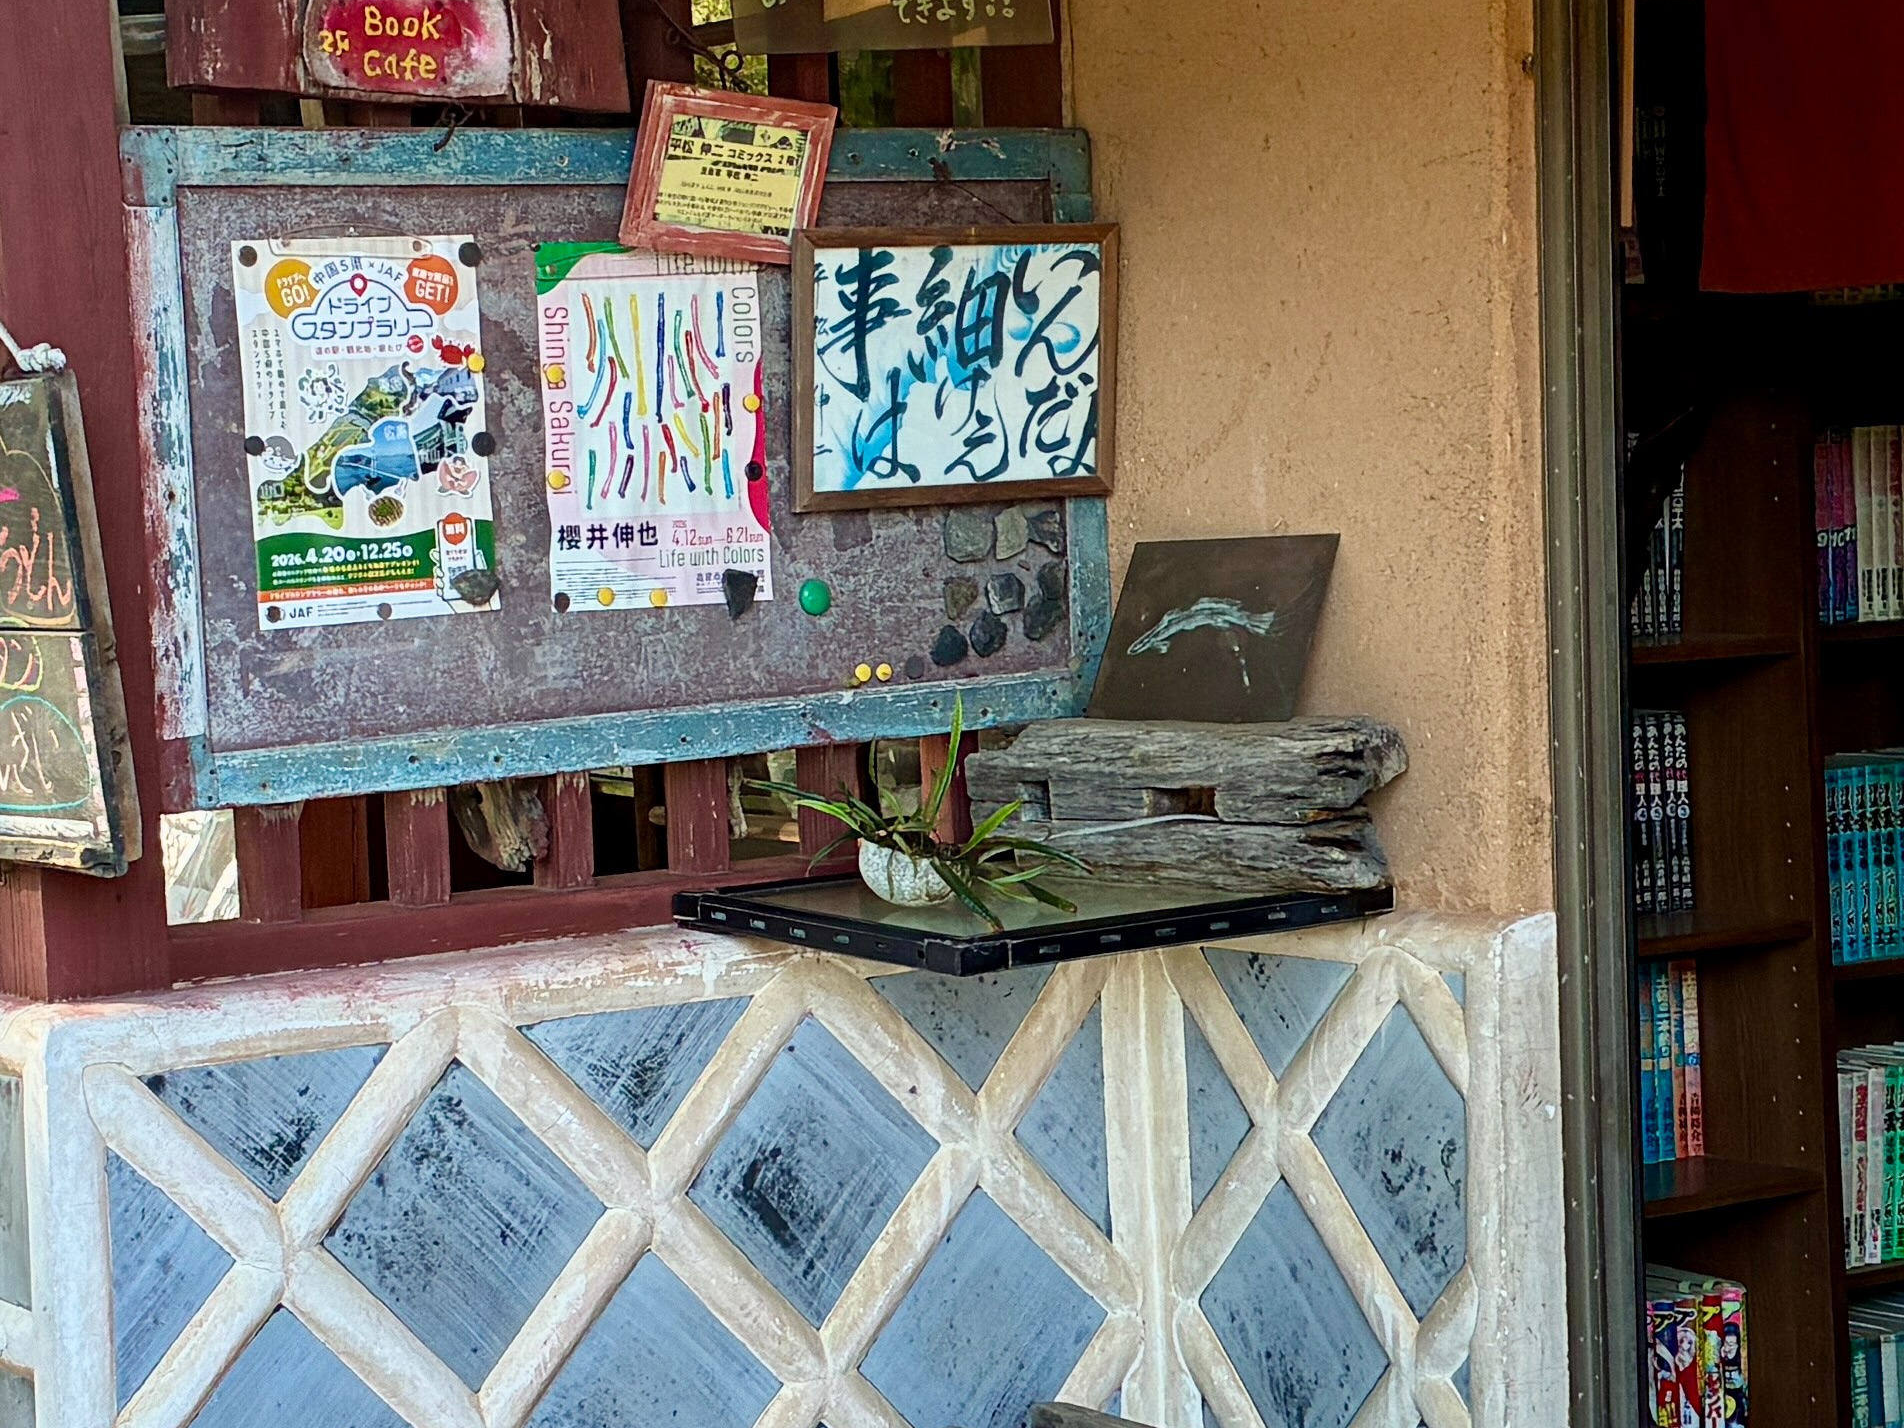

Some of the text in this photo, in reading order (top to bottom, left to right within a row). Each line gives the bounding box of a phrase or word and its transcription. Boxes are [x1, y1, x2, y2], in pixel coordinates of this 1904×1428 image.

[364, 5, 442, 41] Book
[363, 48, 437, 81] Cafe
[728, 149, 773, 163] コミックス
[377, 261, 404, 283] JAF
[280, 285, 311, 308] GO!
[415, 281, 450, 303] GET!
[328, 295, 392, 315] ドライブ
[300, 316, 433, 340] スタンプラリー
[732, 286, 756, 363] Colors
[557, 521, 658, 551] 櫻井伸也
[672, 529, 696, 546] 4.12
[659, 547, 764, 568] Life with Colors
[289, 606, 314, 619] JAF
